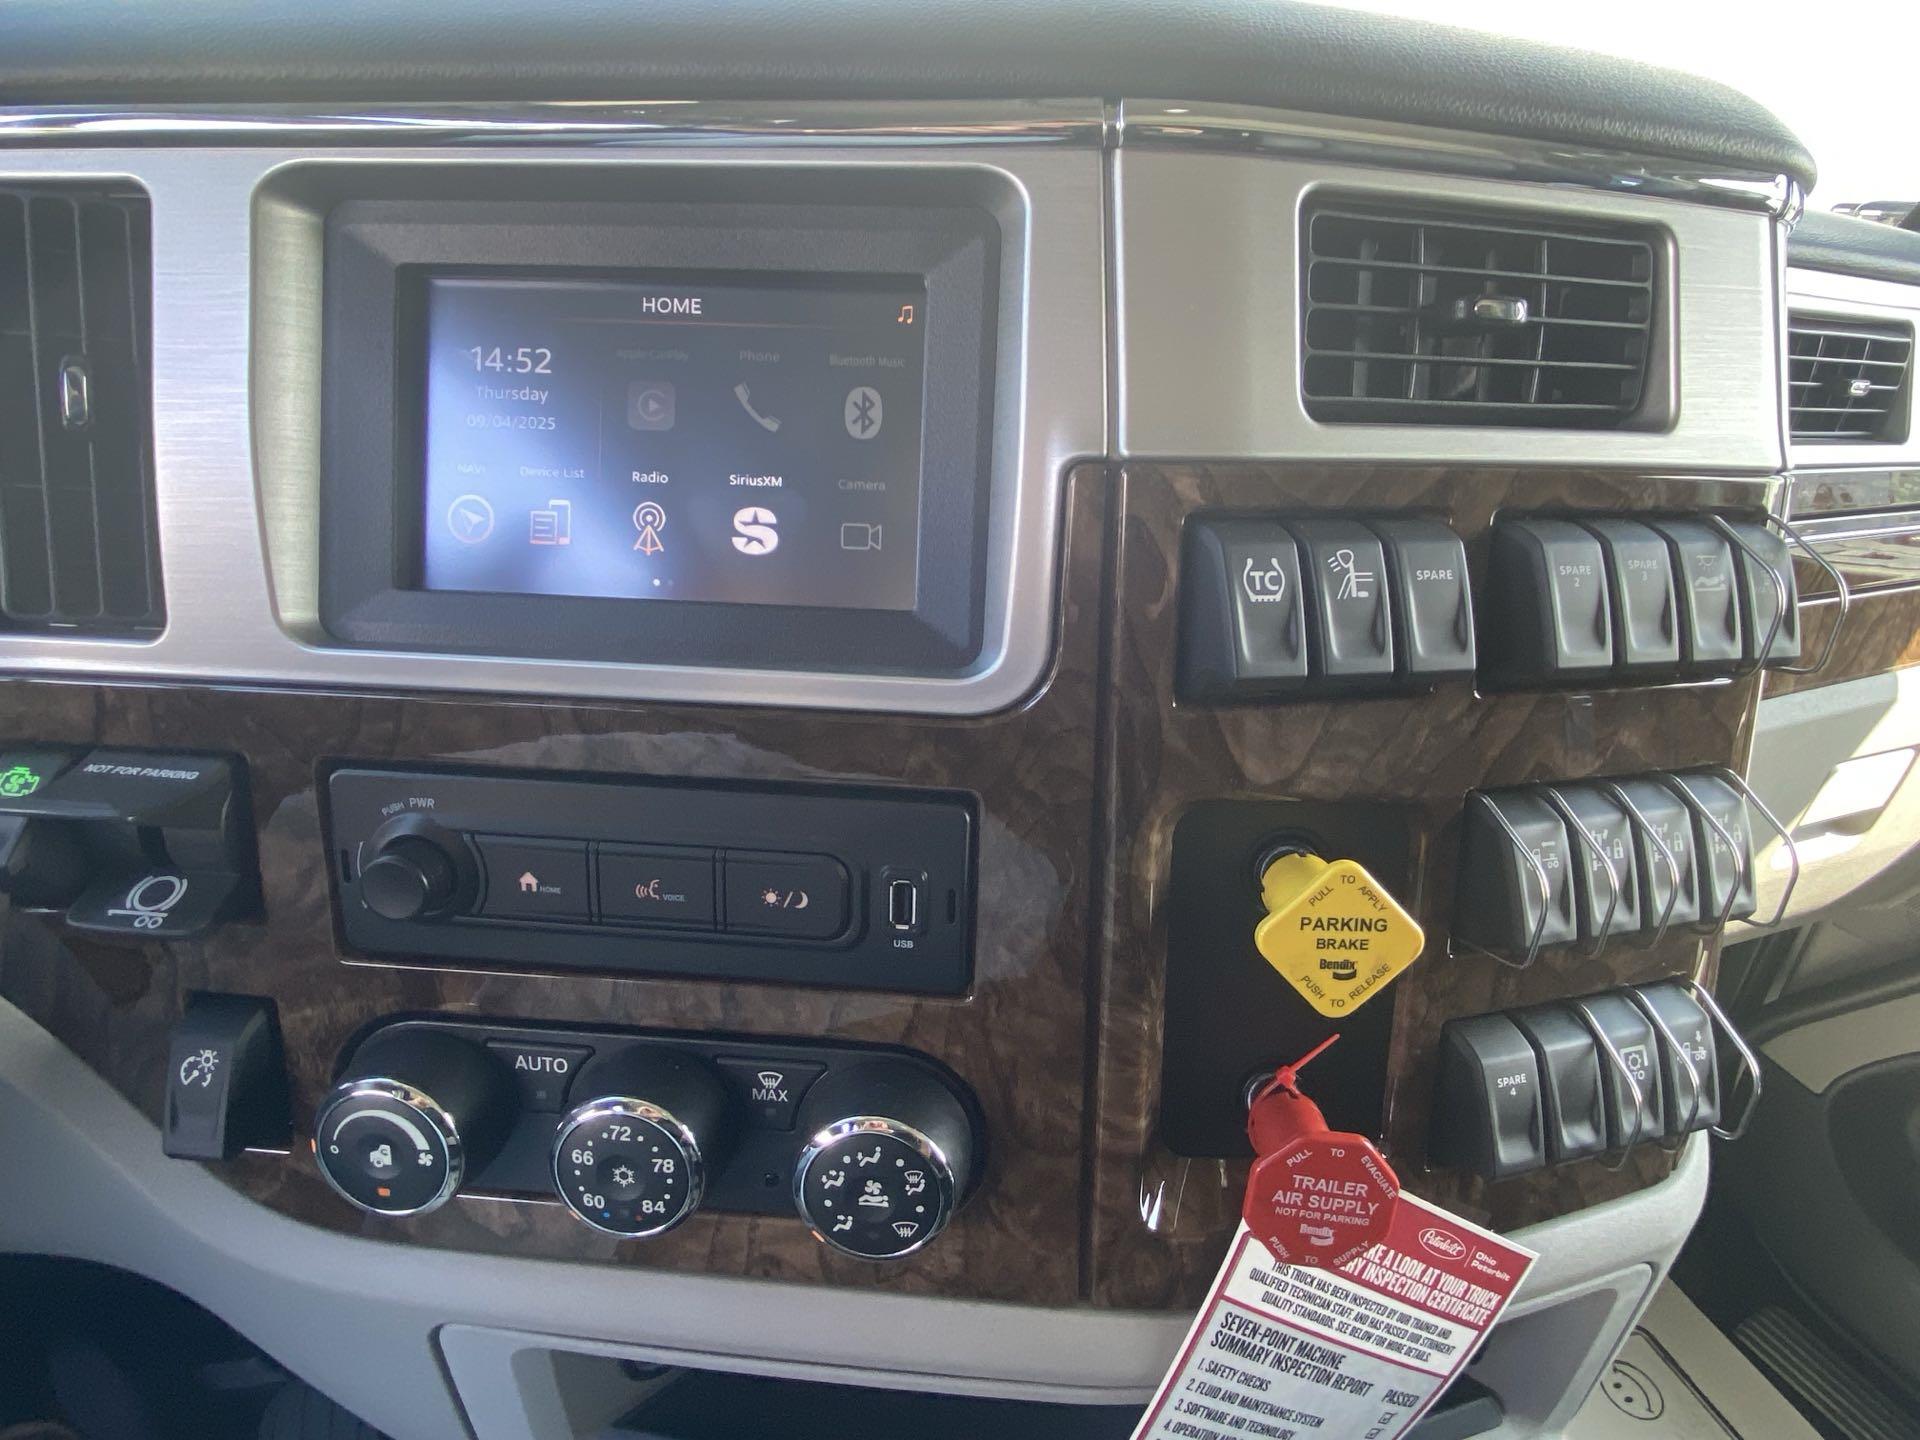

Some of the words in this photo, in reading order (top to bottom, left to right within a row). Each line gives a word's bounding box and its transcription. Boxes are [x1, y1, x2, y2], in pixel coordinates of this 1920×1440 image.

[642, 297, 702, 315] HOME
[471, 345, 552, 374] 14:52
[739, 351, 780, 363] Phone
[829, 354, 875, 367] Bluetooth
[477, 386, 549, 404] Thursday
[466, 414, 556, 431] 09/04/2025
[519, 465, 561, 478] Device
[563, 467, 585, 479] List
[632, 471, 669, 485] Radio
[729, 473, 783, 488] SiriusXM
[838, 478, 886, 493] Camera
[1559, 565, 1593, 577] SPARE
[1627, 559, 1658, 571] SPARE
[1249, 571, 1280, 591] TC
[1416, 569, 1454, 581] SPARE
[1573, 578, 1582, 588] 2
[83, 763, 114, 774] NOT
[111, 765, 142, 776] FOR
[139, 768, 200, 780] PARKING
[381, 801, 406, 816] PUSH
[408, 797, 435, 809] PWR
[1309, 885, 1335, 907] PULL
[1339, 874, 1356, 886] TO
[1358, 885, 1388, 912] APPLY
[1300, 916, 1388, 933] PARKING
[893, 939, 915, 950] USB
[1316, 938, 1369, 951] BRAKE
[1319, 958, 1357, 971] Bendix
[1301, 975, 1327, 1000] PUSH
[1330, 999, 1345, 1008] TO
[1348, 964, 1392, 1000] RELEASE
[514, 1055, 569, 1075] AUTO
[1497, 1073, 1527, 1088] SPARE
[752, 1088, 789, 1102] MAX
[1509, 1087, 1518, 1097] 4
[609, 1125, 631, 1142] 72
[571, 1149, 594, 1166] 66
[651, 1158, 675, 1174] 78
[1286, 1148, 1313, 1168] PULL
[1330, 1148, 1345, 1158] TO
[1360, 1155, 1396, 1200] EVACUATE
[1292, 1174, 1368, 1198] TRAILER
[582, 1193, 605, 1209] 60
[642, 1200, 666, 1214] 84
[1272, 1190, 1303, 1206] AIR
[1308, 1195, 1380, 1216] SUPPLY
[1275, 1206, 1299, 1217] NOT
[1300, 1209, 1322, 1220] FOR
[1324, 1213, 1370, 1226] PARKING
[1269, 1235, 1291, 1259] PUSH
[1304, 1255, 1319, 1264] TO
[1333, 1240, 1370, 1266] SUPPLY
[1422, 1230, 1465, 1256] Peterbilt
[1382, 1250, 1397, 1266] A
[1389, 1253, 1427, 1279] LOOK
[1475, 1252, 1497, 1265] Ohio
[1420, 1267, 1440, 1285] AT
[1470, 1260, 1511, 1281] Peterbilt
[1434, 1273, 1469, 1296] YOUR
[1248, 1268, 1290, 1291] QUALIFIED
[1286, 1284, 1333, 1309] TECHNICIAN
[1352, 1312, 1370, 1324] AND
[1367, 1318, 1384, 1329] HAS
[1382, 1323, 1408, 1338] PASSED
[1271, 1261, 1290, 1275] THIS
[1289, 1268, 1316, 1286] TRUCK
[1314, 1279, 1332, 1292] HAS
[1329, 1286, 1351, 1300] BEEN
[1348, 1294, 1388, 1315] INSPECTED
[1386, 1309, 1398, 1318] BY
[1395, 1312, 1412, 1324] OUR
[1409, 1317, 1438, 1334] TRAINED
[1436, 1328, 1452, 1338] AND
[1360, 1263, 1432, 1302] INSPECTION
[1424, 1290, 1491, 1325] CERTIFICATE
[1462, 1285, 1501, 1309] TRUCK
[1260, 1291, 1294, 1311] QUALITY
[1291, 1304, 1337, 1328] STANDARDS.
[1335, 1321, 1351, 1333] SEE
[1349, 1326, 1374, 1341] BELOW
[1371, 1335, 1388, 1346] FOR
[1385, 1340, 1406, 1352] MORE
[1219, 1312, 1298, 1352] SEVEN-POINT
[1293, 1341, 1346, 1369] MACHINE
[1210, 1330, 1273, 1364] SUMMARY
[1268, 1352, 1336, 1385] INSPECTION
[1330, 1374, 1373, 1396] REPORT
[1204, 1361, 1239, 1380] SAFETY
[1236, 1372, 1271, 1390] CHECKS
[1186, 1378, 1196, 1390] 2.
[1195, 1382, 1221, 1398] FLUID
[1219, 1390, 1239, 1403] AND
[1237, 1395, 1295, 1419] MAINTENANCE
[1292, 1412, 1324, 1427] SYSTEM
[1381, 1388, 1419, 1409] PASSED
[1174, 1399, 1185, 1410] 3.
[1183, 1402, 1230, 1423] SOFTWARE
[1227, 1415, 1247, 1428] AND
[1245, 1420, 1295, 1440] TECHNOLOGY
[1163, 1419, 1174, 1430] 4.
[1171, 1422, 1220, 1440] OPERATION
